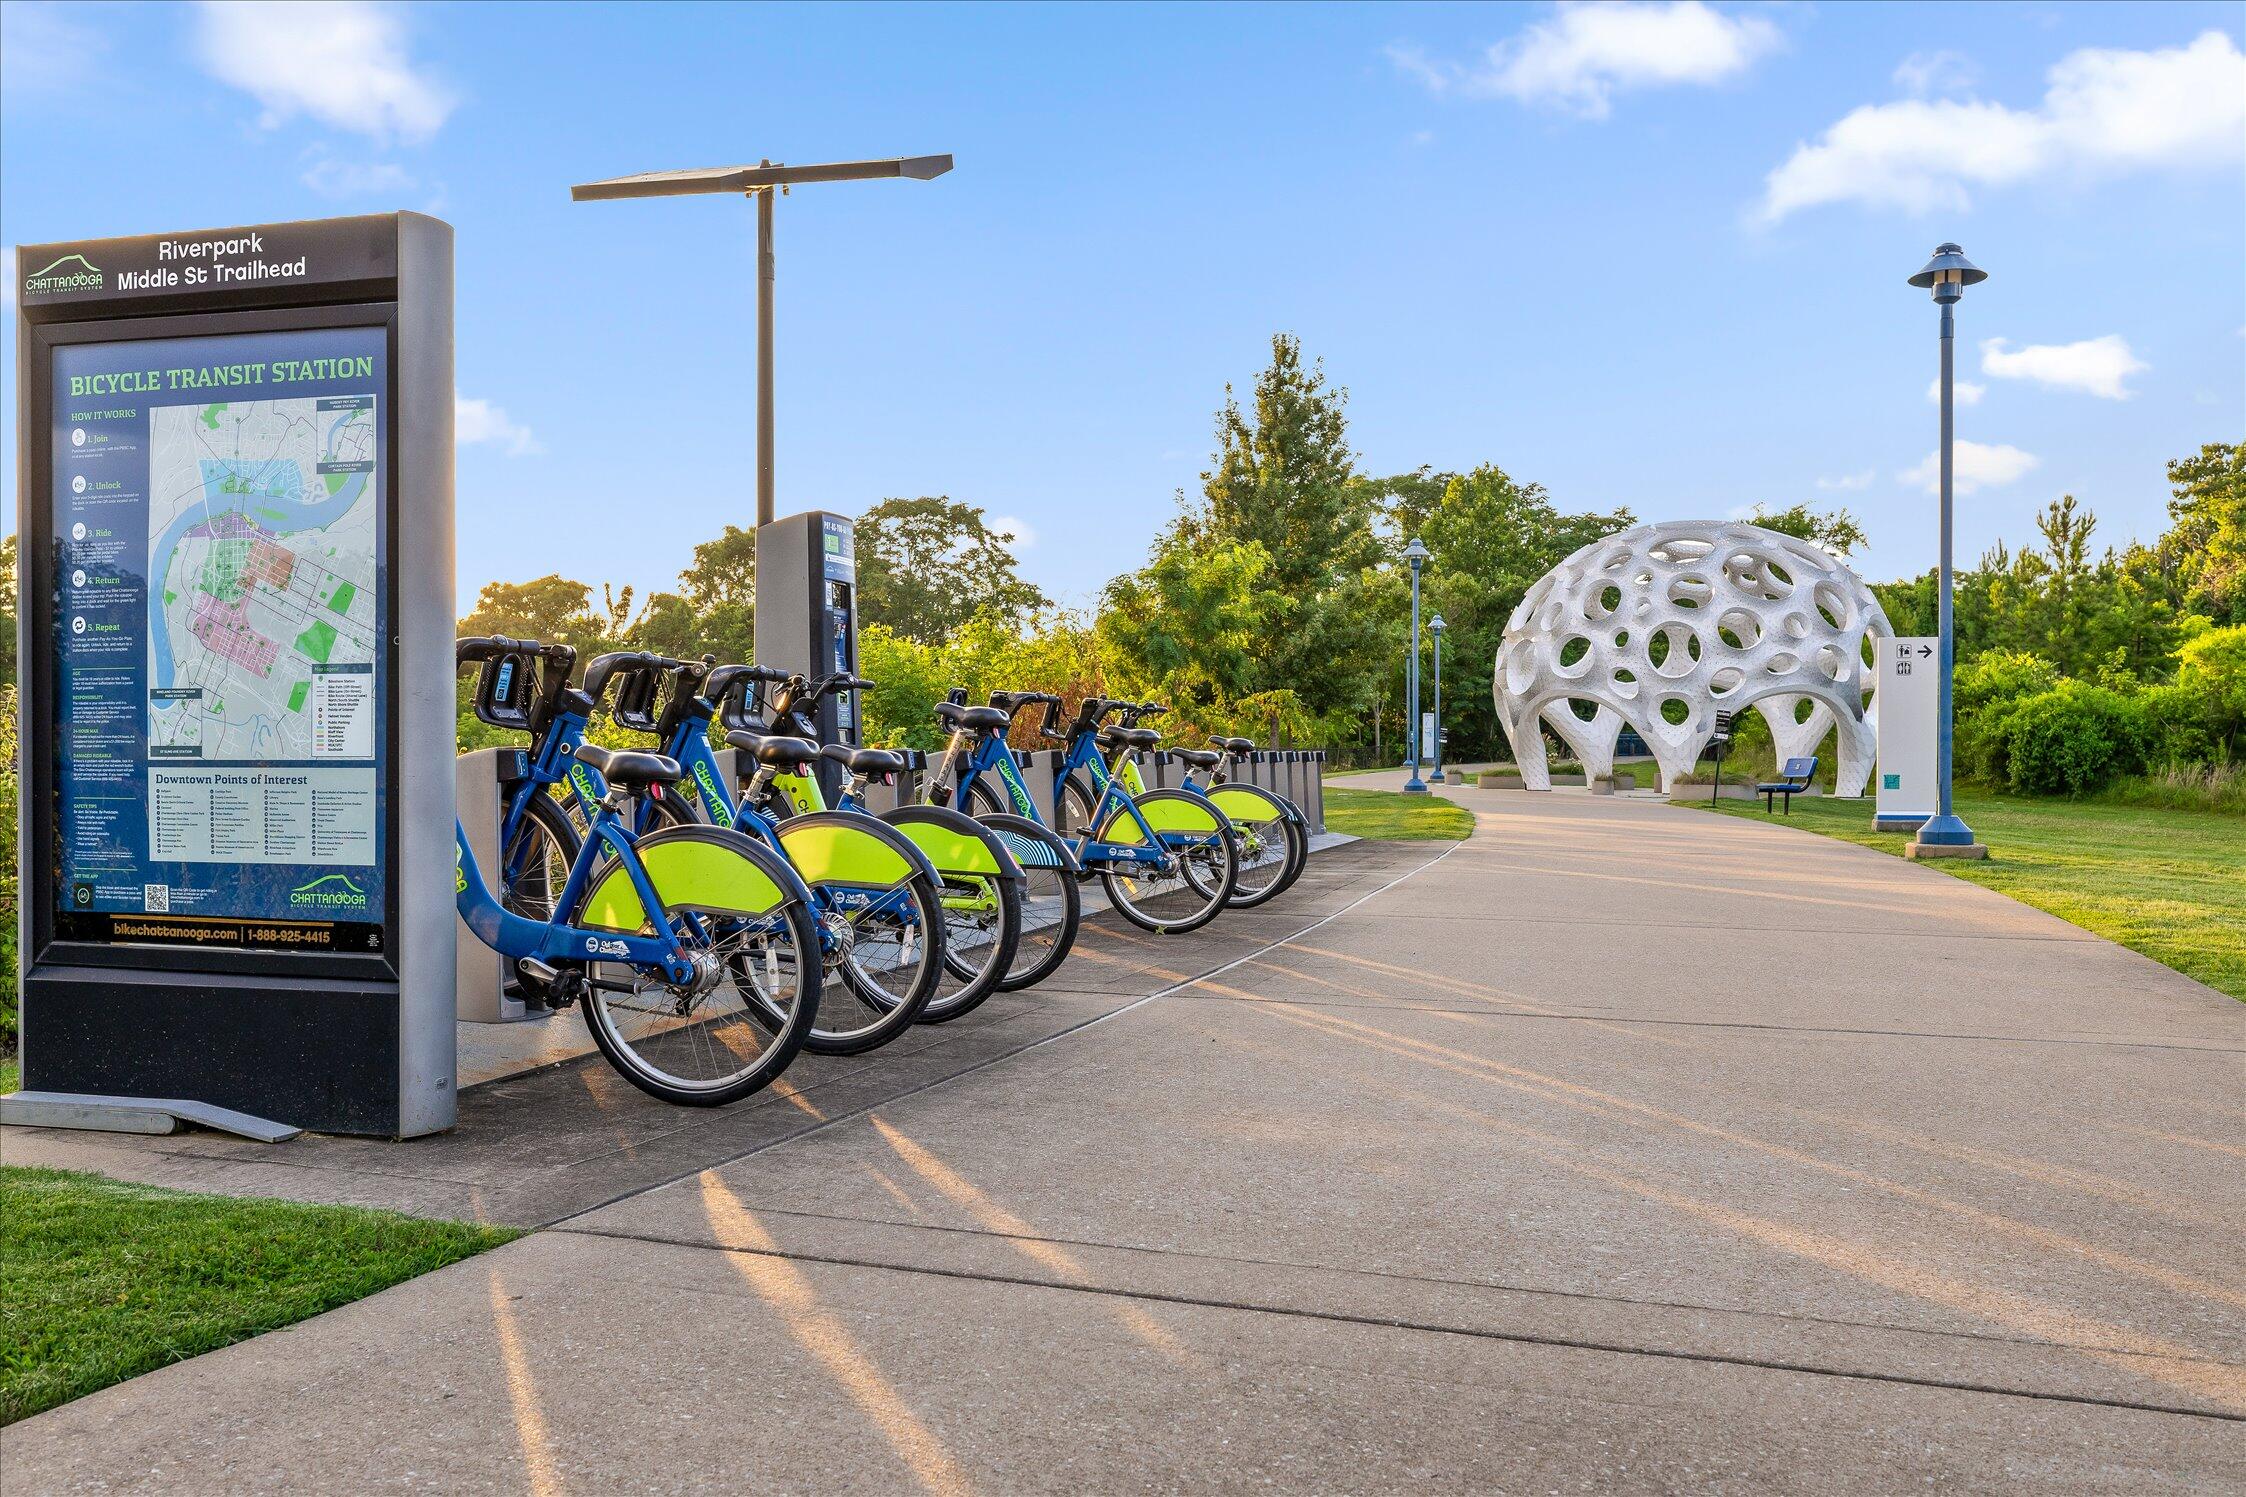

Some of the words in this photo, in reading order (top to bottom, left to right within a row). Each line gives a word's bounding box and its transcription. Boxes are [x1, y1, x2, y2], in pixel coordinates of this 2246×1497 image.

[159, 232, 263, 262] Riverpark
[118, 267, 178, 291] Middle
[184, 264, 208, 285] St
[214, 256, 306, 283] Trailhead
[26, 273, 102, 290] CHATTANOOGA
[70, 370, 161, 397] BICYCLE
[166, 363, 266, 390] TRANSIT
[271, 356, 373, 384] STATION
[71, 411, 93, 421] HOW
[93, 411, 102, 420] IT
[102, 408, 137, 419] WORKS
[93, 434, 108, 444] Join
[88, 482, 95, 490] 2.
[95, 481, 122, 490] Unlock
[87, 529, 94, 538] 3.
[95, 528, 112, 537] Ride
[95, 576, 120, 584] Return
[87, 623, 94, 632] 5.
[95, 623, 121, 632] Repeat
[156, 774, 212, 784] Downtown
[214, 774, 248, 784] Points
[250, 774, 262, 785] of
[264, 774, 308, 785] Interest
[290, 892, 366, 905] CHATTANOOGA
[113, 922, 237, 941] bikechattanooga.com
[247, 928, 331, 943] 1-888-925-4415
